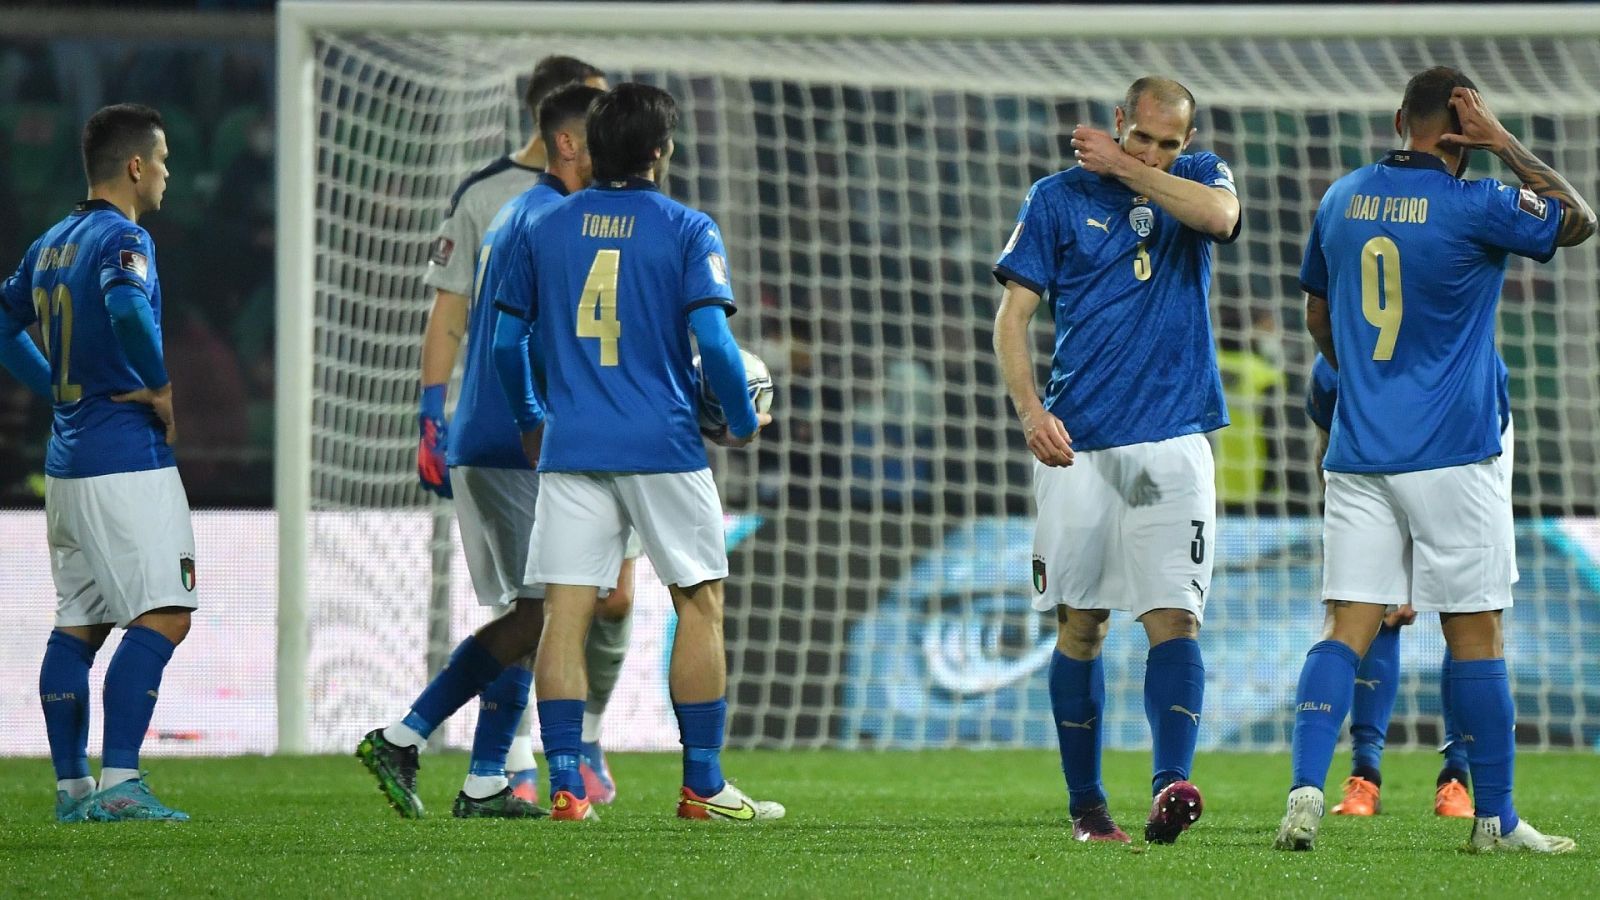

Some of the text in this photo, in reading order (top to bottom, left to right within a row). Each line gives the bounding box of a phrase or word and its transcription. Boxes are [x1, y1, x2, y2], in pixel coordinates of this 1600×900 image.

[581, 213, 636, 238] TONALI
[1345, 194, 1429, 224] JOAO PEDRO
[576, 249, 621, 367] 4
[1361, 236, 1403, 361] 9
[1190, 519, 1206, 565] 3
